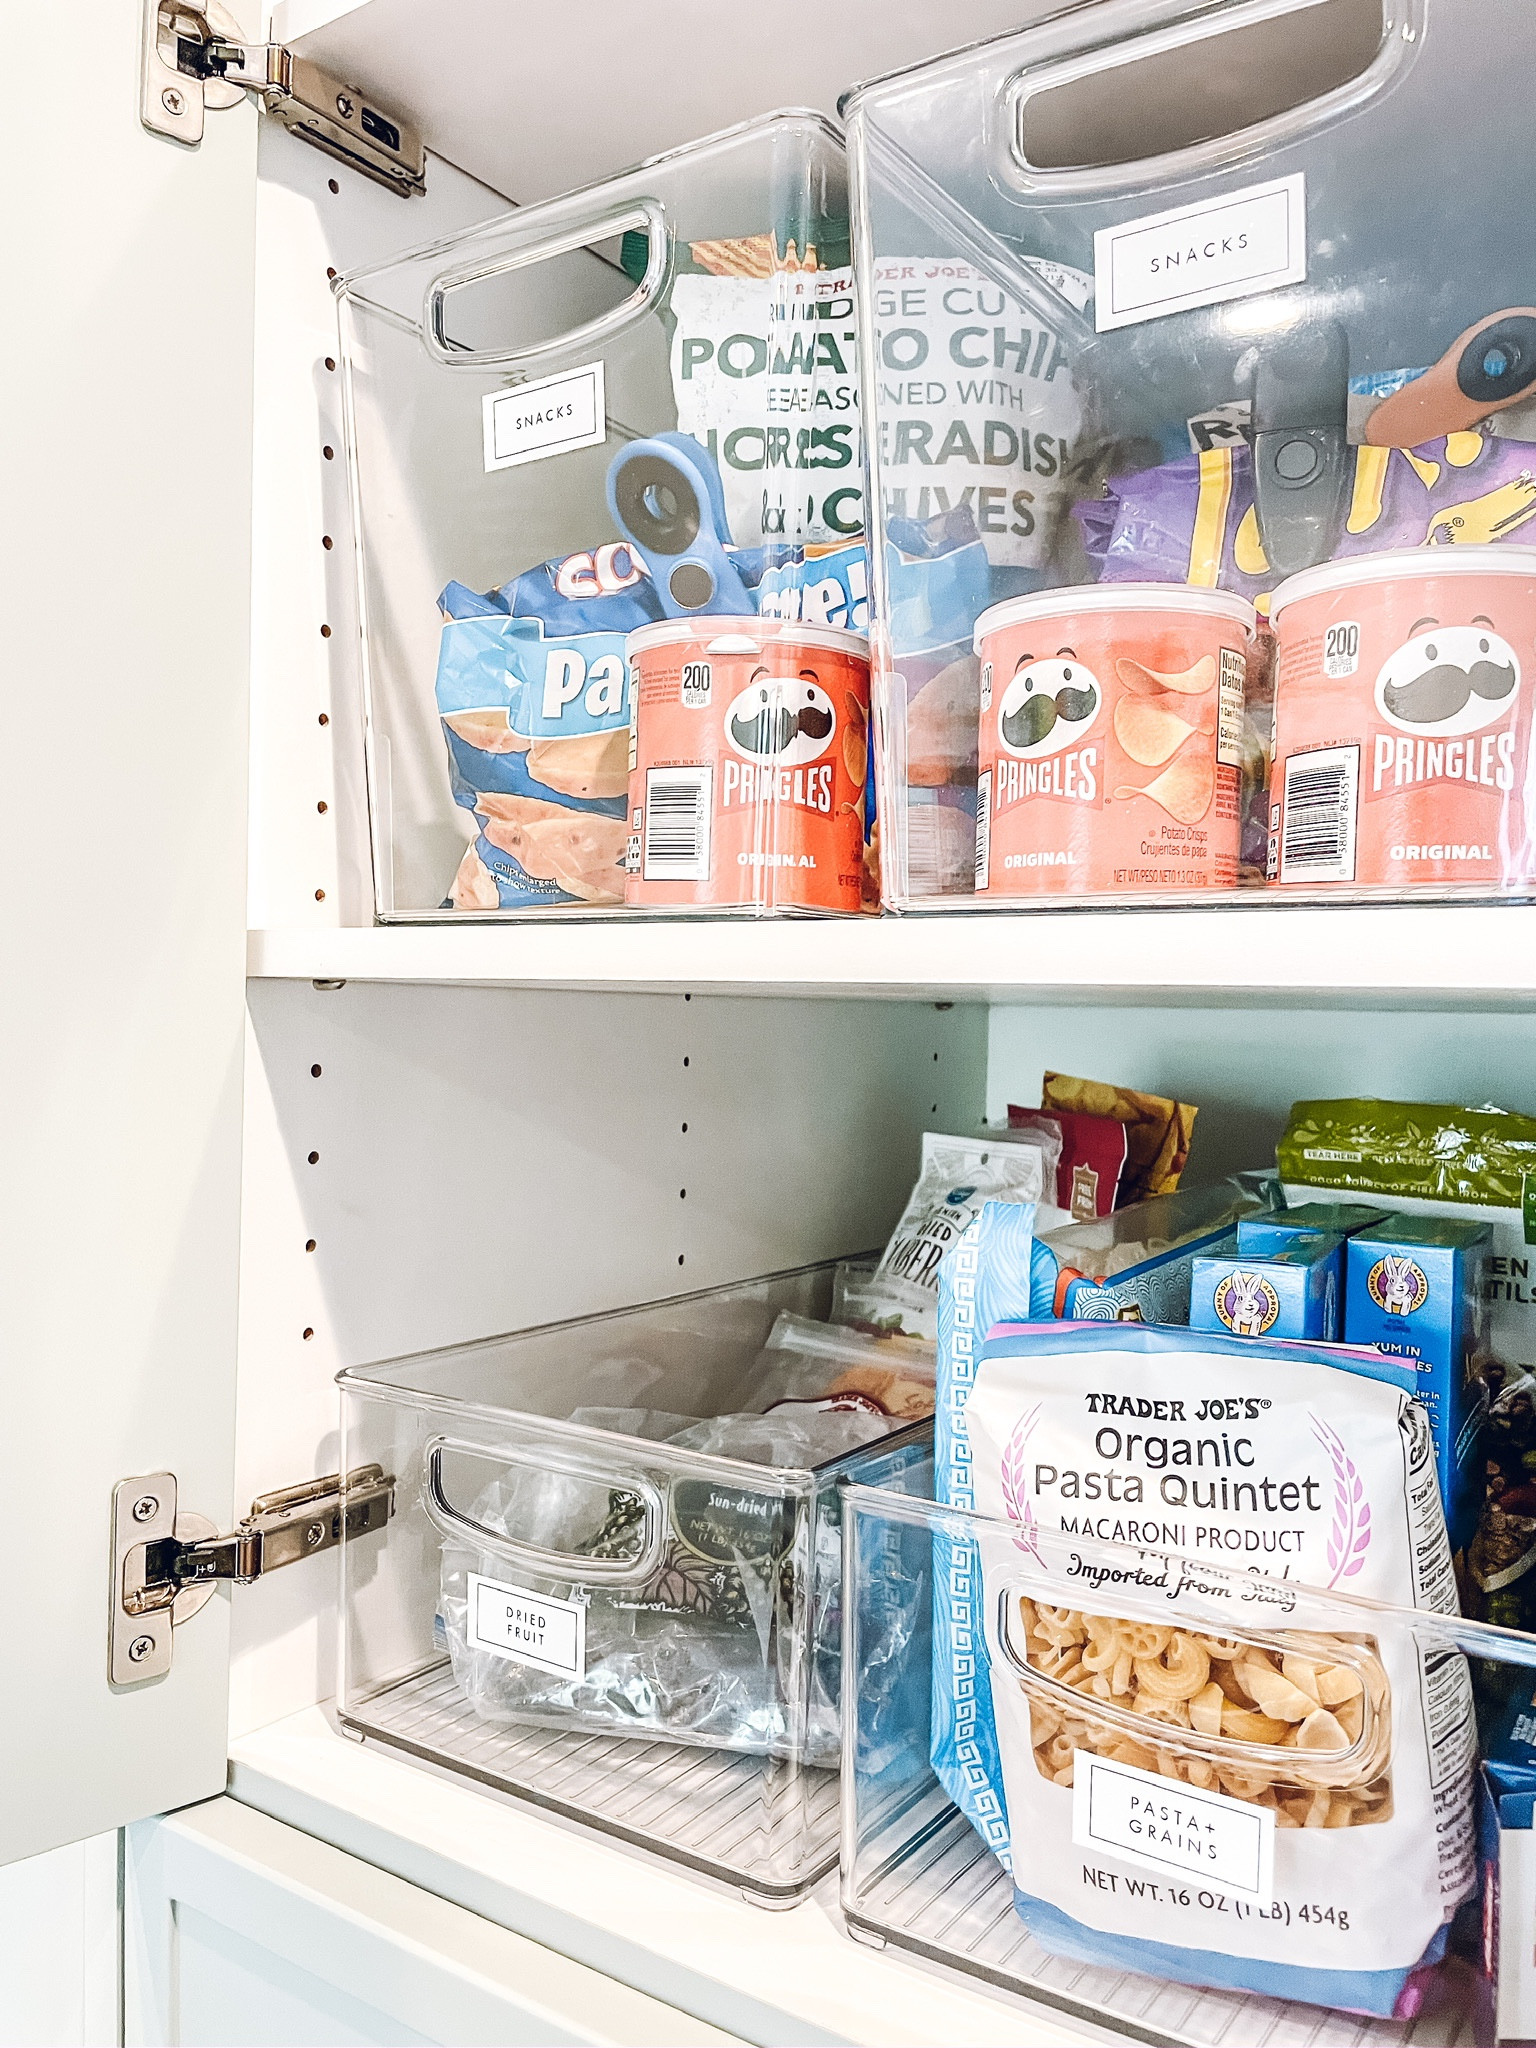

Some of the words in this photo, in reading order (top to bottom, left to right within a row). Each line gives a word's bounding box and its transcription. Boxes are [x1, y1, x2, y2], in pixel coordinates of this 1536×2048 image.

[1149, 233, 1250, 273] SNACKS
[942, 287, 1026, 317] CU
[957, 379, 1024, 412] WITH
[515, 403, 574, 431] SNACKS
[1326, 625, 1359, 658] 200
[683, 664, 711, 691] 200
[1373, 731, 1516, 794] PRINGLES
[996, 748, 1097, 810] PRINGLES
[1340, 775, 1350, 812] 84551
[1161, 826, 1186, 841] Potato
[1187, 827, 1208, 843] Crisps
[1004, 852, 1077, 869] ORIGINAL
[1181, 844, 1191, 856] de
[1390, 844, 1493, 862] ORIGINAL
[1373, 1266, 1381, 1275] OF
[1220, 1281, 1229, 1291] OF
[1369, 1274, 1381, 1301] BUNNY
[1413, 1268, 1426, 1306] APPROVAL
[1216, 1292, 1229, 1321] BUNNY
[1263, 1285, 1277, 1326] APPROVAL
[1406, 1346, 1421, 1357] IN
[1085, 1393, 1188, 1422] TRADER
[1095, 1427, 1256, 1468] Organic
[1034, 1464, 1145, 1504] Pasta
[1159, 1475, 1323, 1512] Quintet
[708, 1492, 767, 1517] Sun-dried
[689, 1519, 714, 1533] NET
[1060, 1515, 1187, 1547] MACARONI
[1196, 1525, 1306, 1553] PRODUCT
[1066, 1553, 1169, 1589] Imported
[1165, 1575, 1232, 1600] from
[1420, 1573, 1437, 1593] Total
[505, 1606, 547, 1630] DRIED
[506, 1624, 546, 1647] FRUIT
[1429, 1707, 1444, 1724] Iron
[1130, 1795, 1217, 1834] PASTA+
[1128, 1818, 1220, 1861] GRAINS
[1082, 1864, 1119, 1893] NET
[1125, 1878, 1166, 1902] WT.
[1168, 1886, 1191, 1907] 16
[1198, 1890, 1230, 1913] OZ
[1298, 1905, 1351, 1931] 454g
